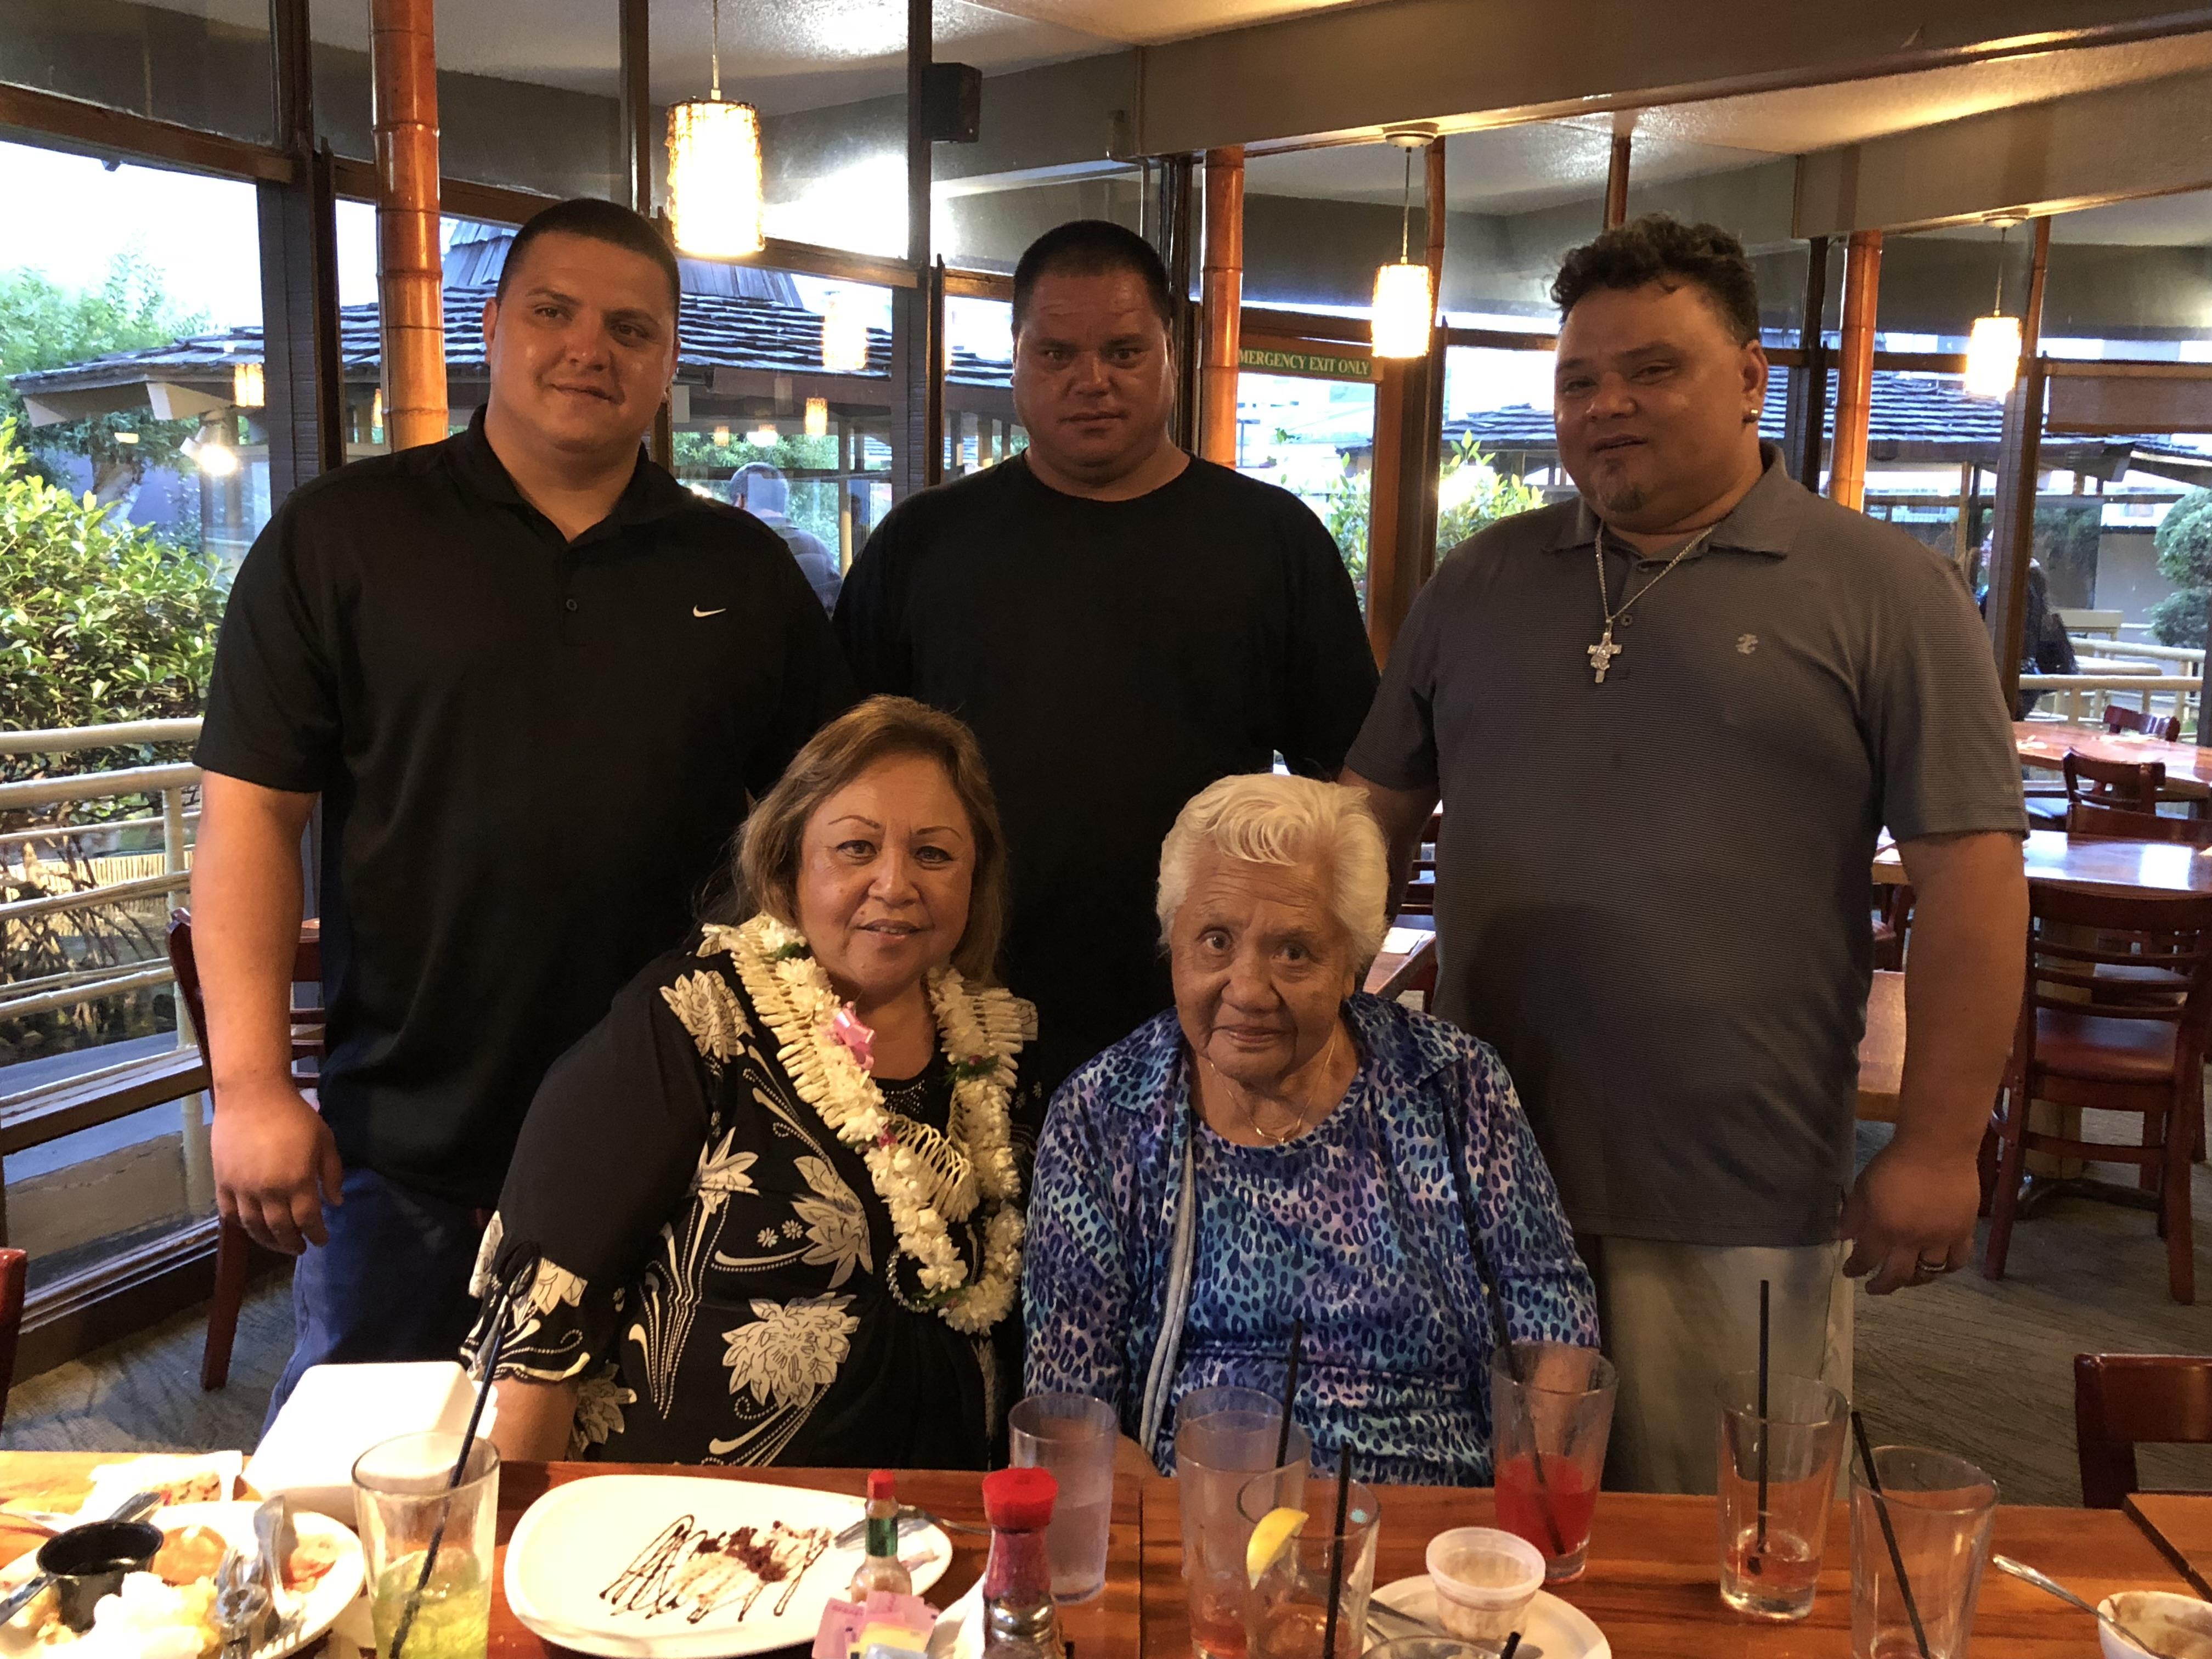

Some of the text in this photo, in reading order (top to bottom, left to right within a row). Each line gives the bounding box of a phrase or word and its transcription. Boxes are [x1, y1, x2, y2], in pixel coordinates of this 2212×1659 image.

[1238, 349, 1369, 375] MERGENCY EXIT ONLY
